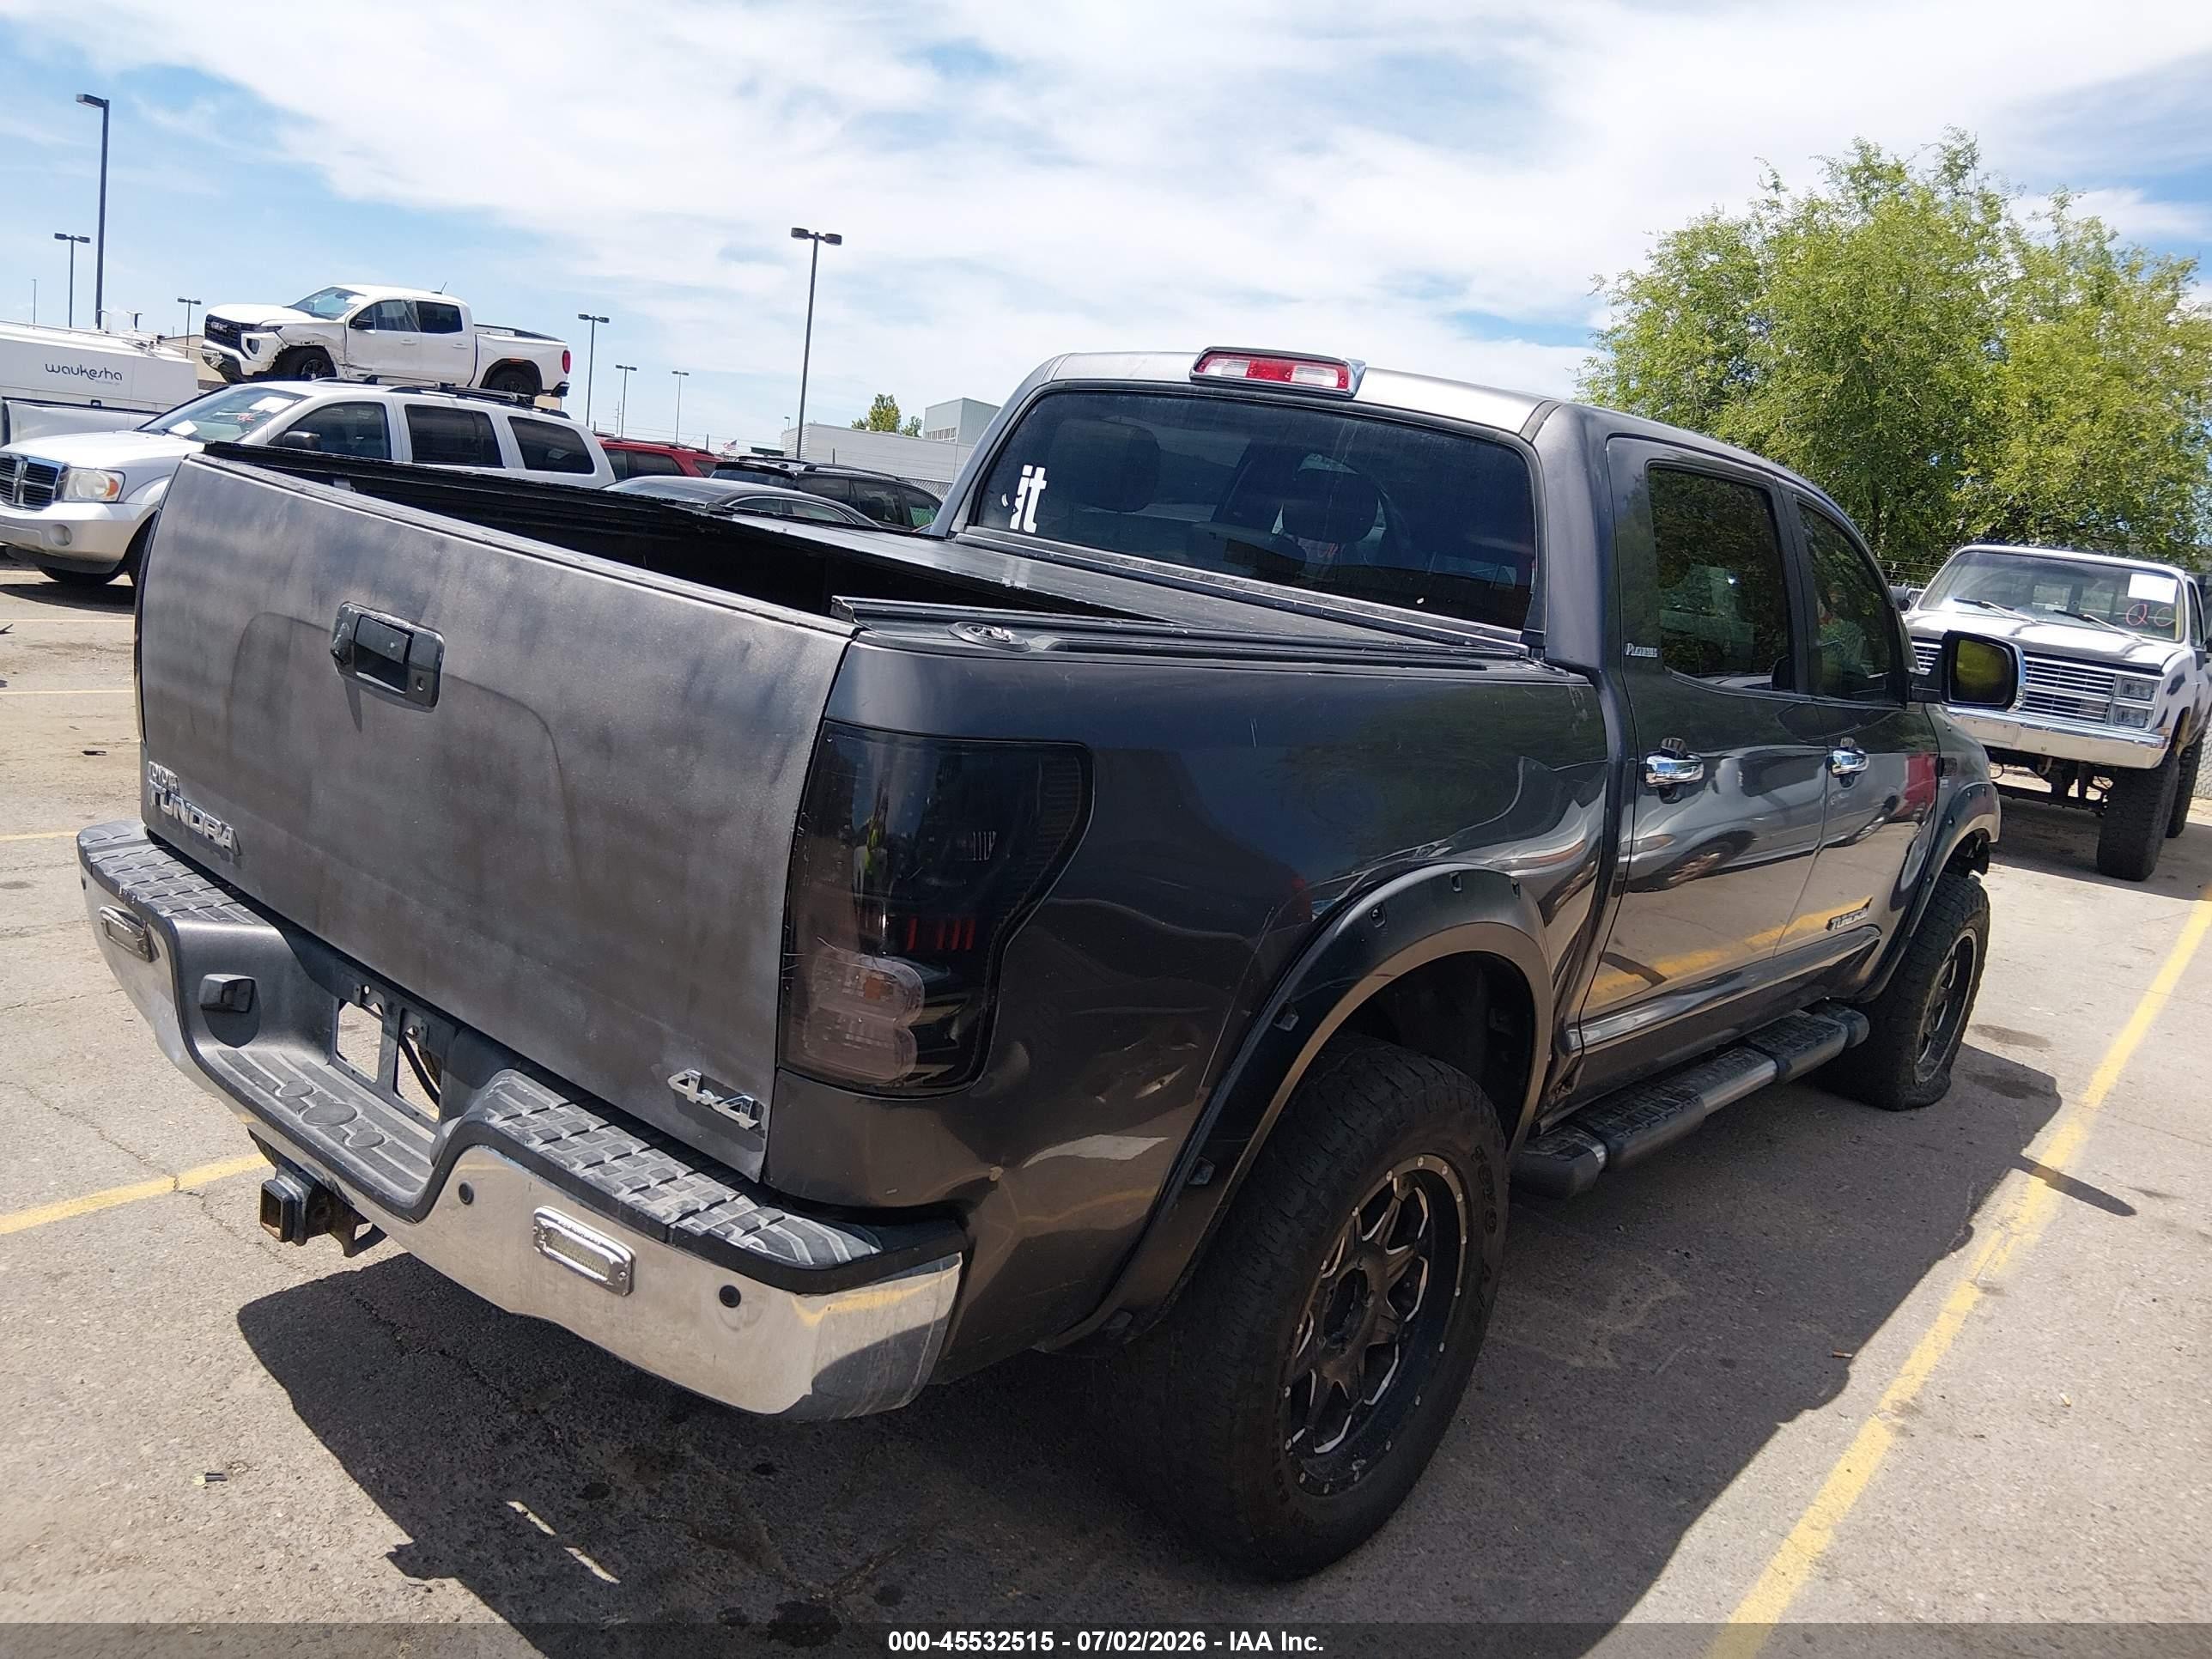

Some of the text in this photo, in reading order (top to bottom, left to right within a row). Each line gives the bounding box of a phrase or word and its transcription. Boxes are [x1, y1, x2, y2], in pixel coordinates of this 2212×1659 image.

[45, 363, 123, 380] waukesha
[148, 779, 236, 849] TUNDRA
[667, 1069, 759, 1130] 4x4
